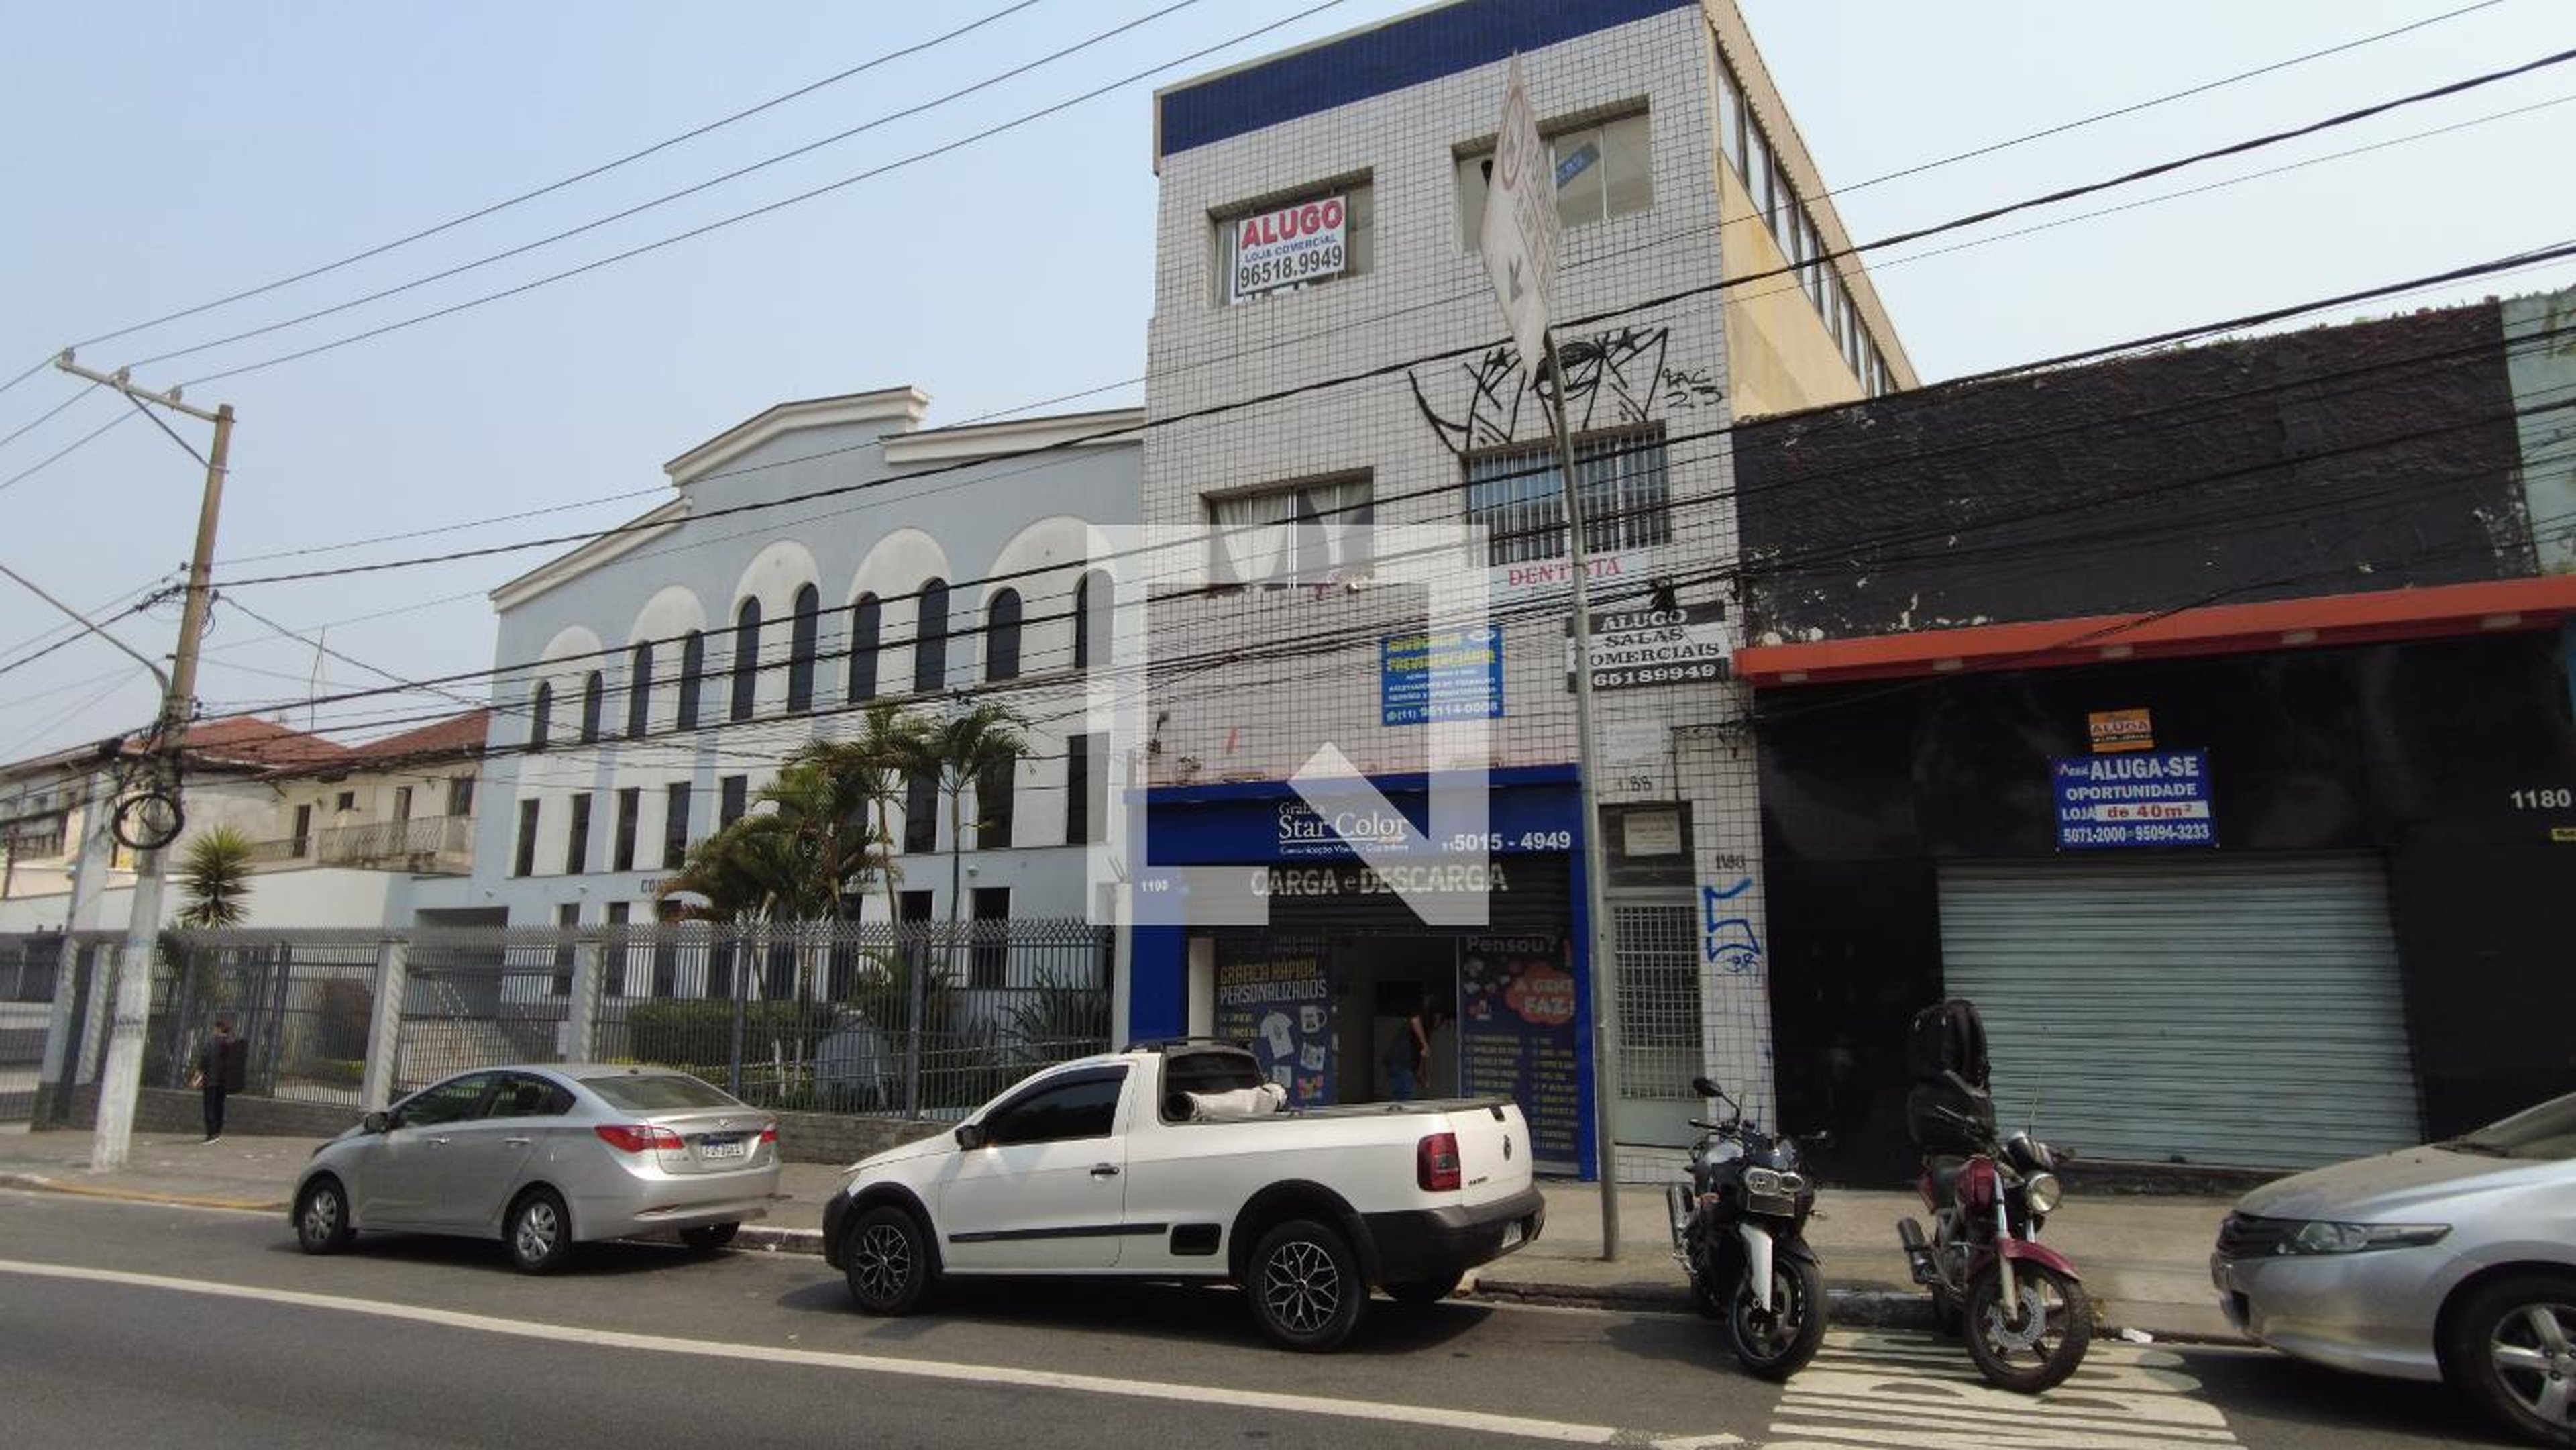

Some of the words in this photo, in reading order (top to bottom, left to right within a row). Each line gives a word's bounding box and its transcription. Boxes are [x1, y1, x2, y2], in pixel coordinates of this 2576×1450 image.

[1242, 200, 1343, 250] ALUGO
[1246, 248, 1272, 262] LOJA
[1275, 235, 1337, 255] COMERCIAL
[1509, 558, 1622, 586] DENTSTA
[1601, 609, 1688, 631] ALUGO
[1604, 628, 1684, 648] SALAS
[1574, 643, 1719, 666] OMERCIAIS
[2093, 720, 2149, 734] ALUGA
[2091, 756, 2199, 780] ALUGA-SE
[2065, 784, 2198, 801] OPORTUNIDADE
[2510, 789, 2571, 809] 1180
[2062, 807, 2096, 821] LOJA
[2107, 805, 2129, 818] de
[1279, 815, 1330, 839] Star
[1336, 810, 1407, 837] Color
[1520, 831, 1571, 850] 4949
[1250, 869, 1340, 895] CARGA
[1344, 876, 1356, 890] e
[1360, 862, 1509, 894] DESCARGA
[1466, 936, 1557, 953] Pensou?
[1220, 978, 1327, 1005] PERSONALIZADOS
